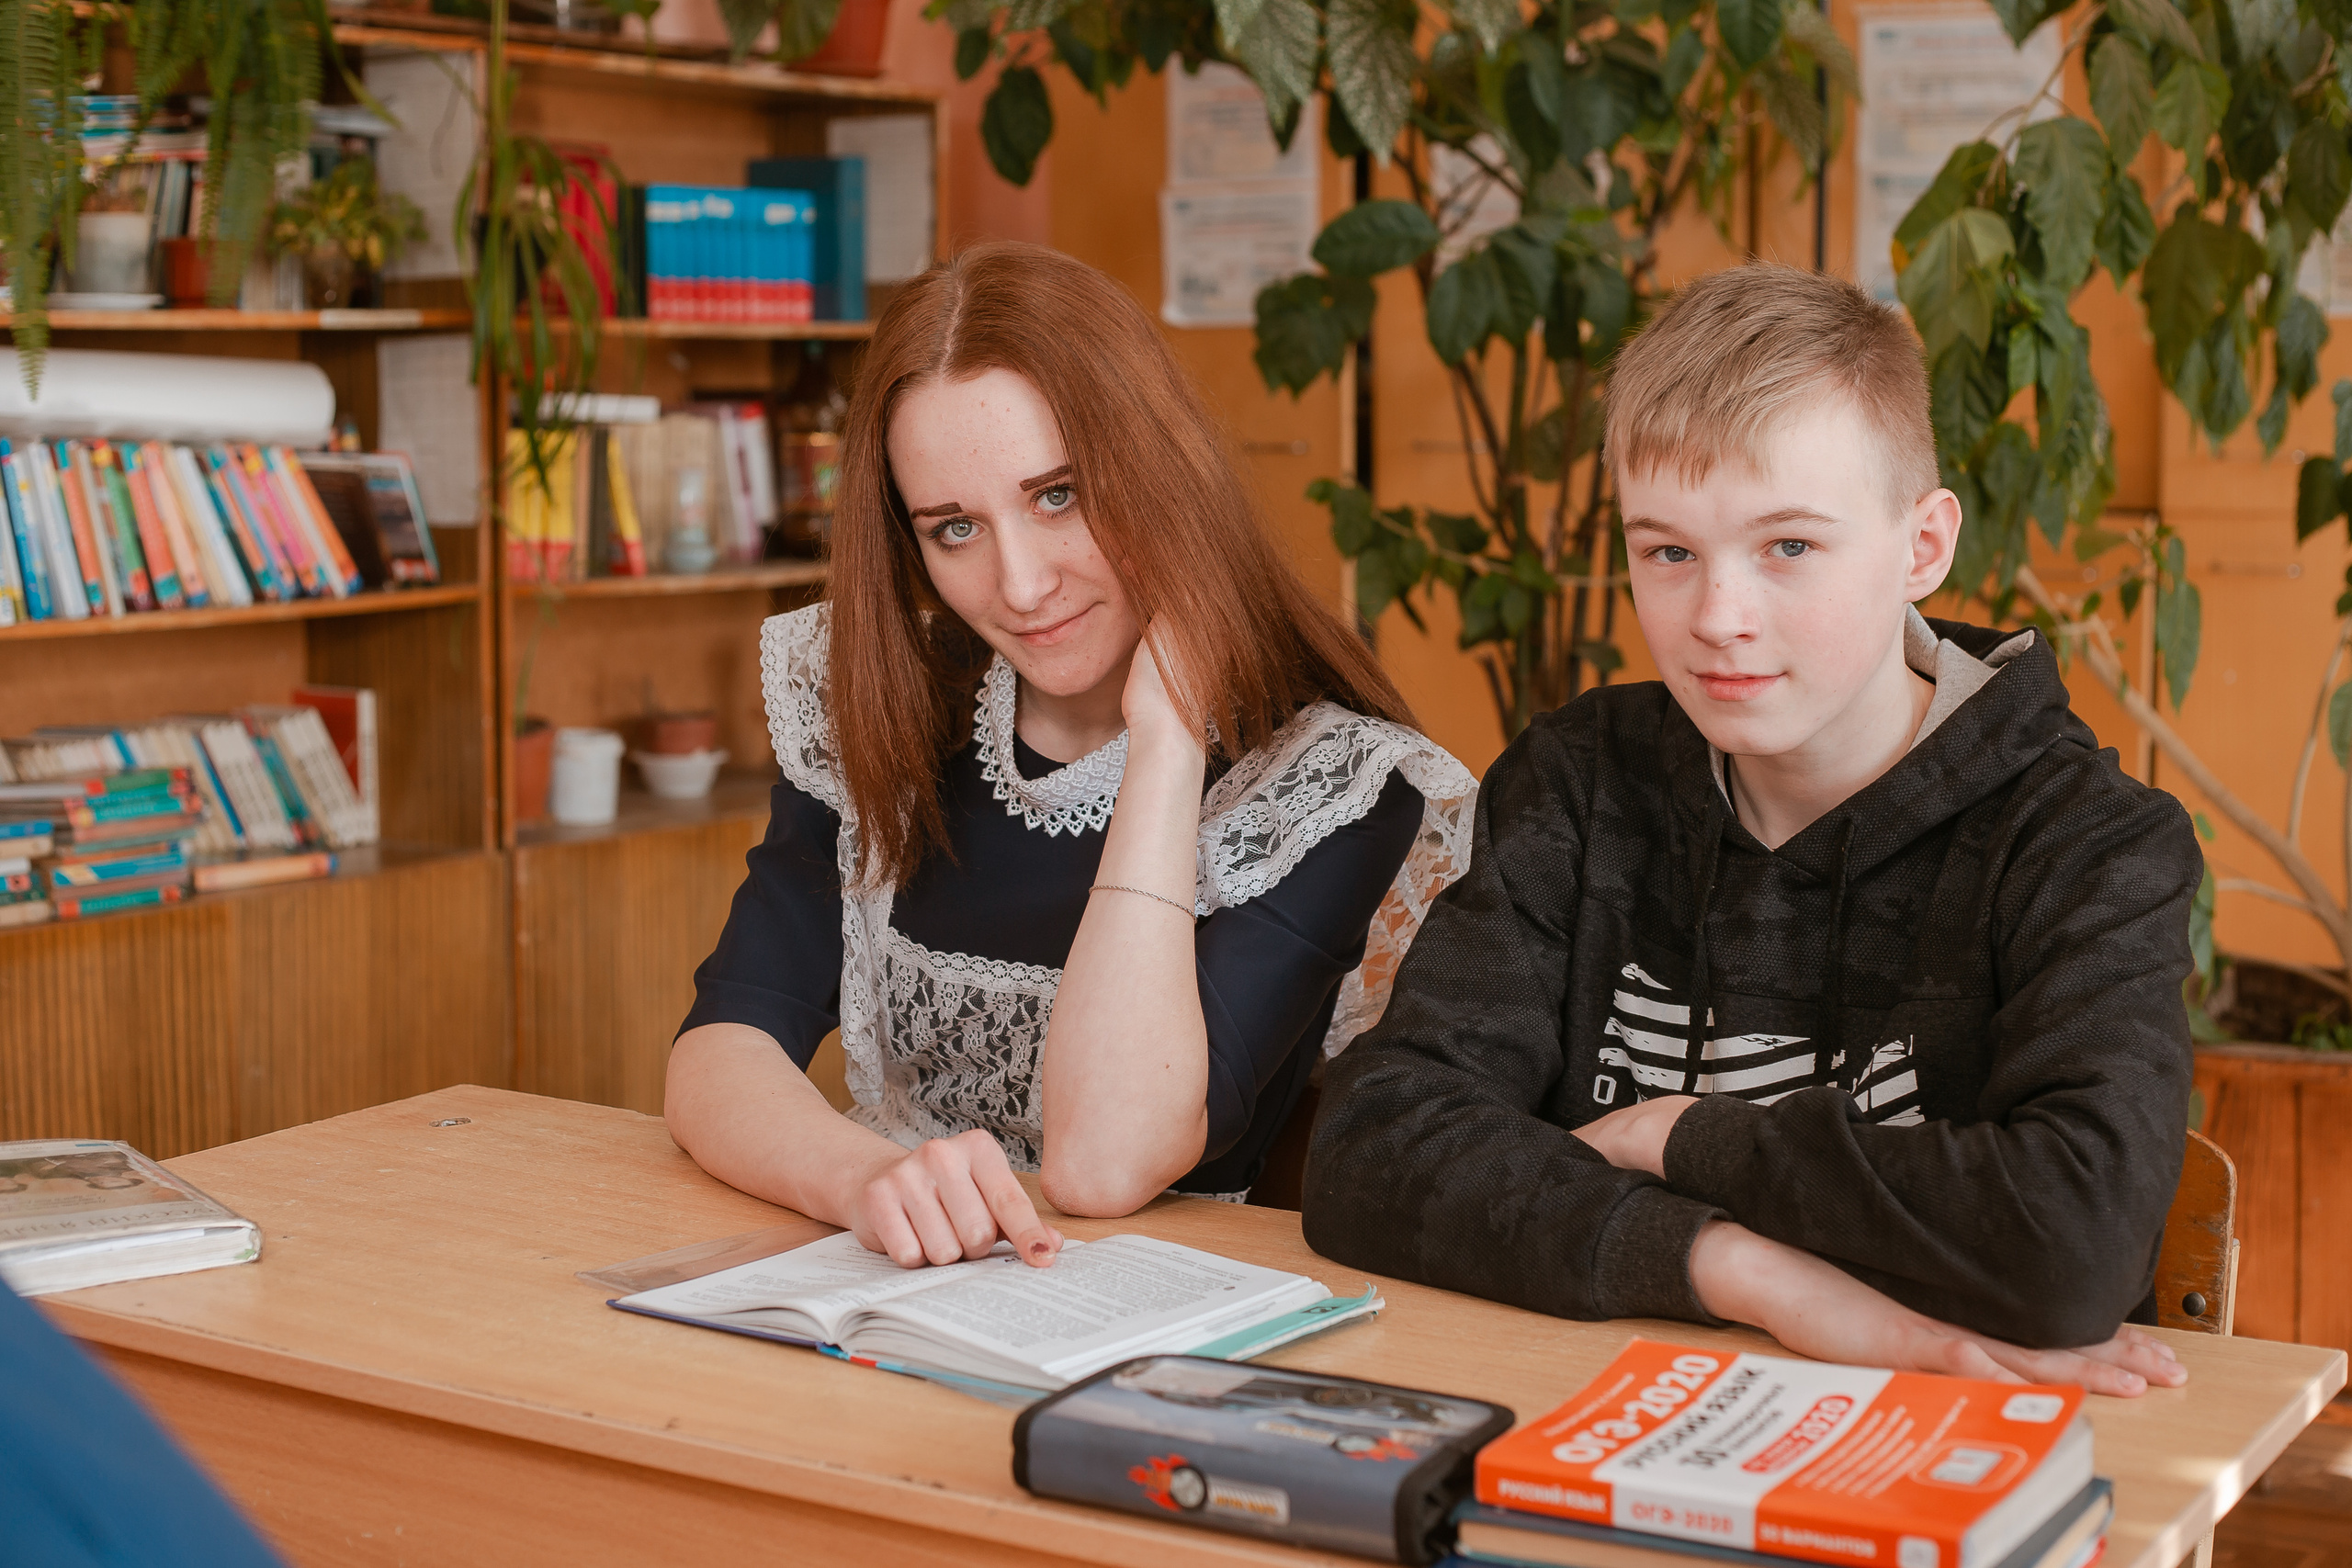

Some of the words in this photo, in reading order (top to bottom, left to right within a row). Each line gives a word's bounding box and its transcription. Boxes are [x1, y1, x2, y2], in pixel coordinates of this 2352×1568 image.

[1552, 1354, 1719, 1463] ОГЭ-2020
[1622, 1413, 1719, 1468] РУССКИЙ
[1705, 1367, 1766, 1414] ЯЗЫК
[1498, 1478, 1562, 1506] РУССКИЙ
[1565, 1490, 1608, 1513] ЯЗЫК
